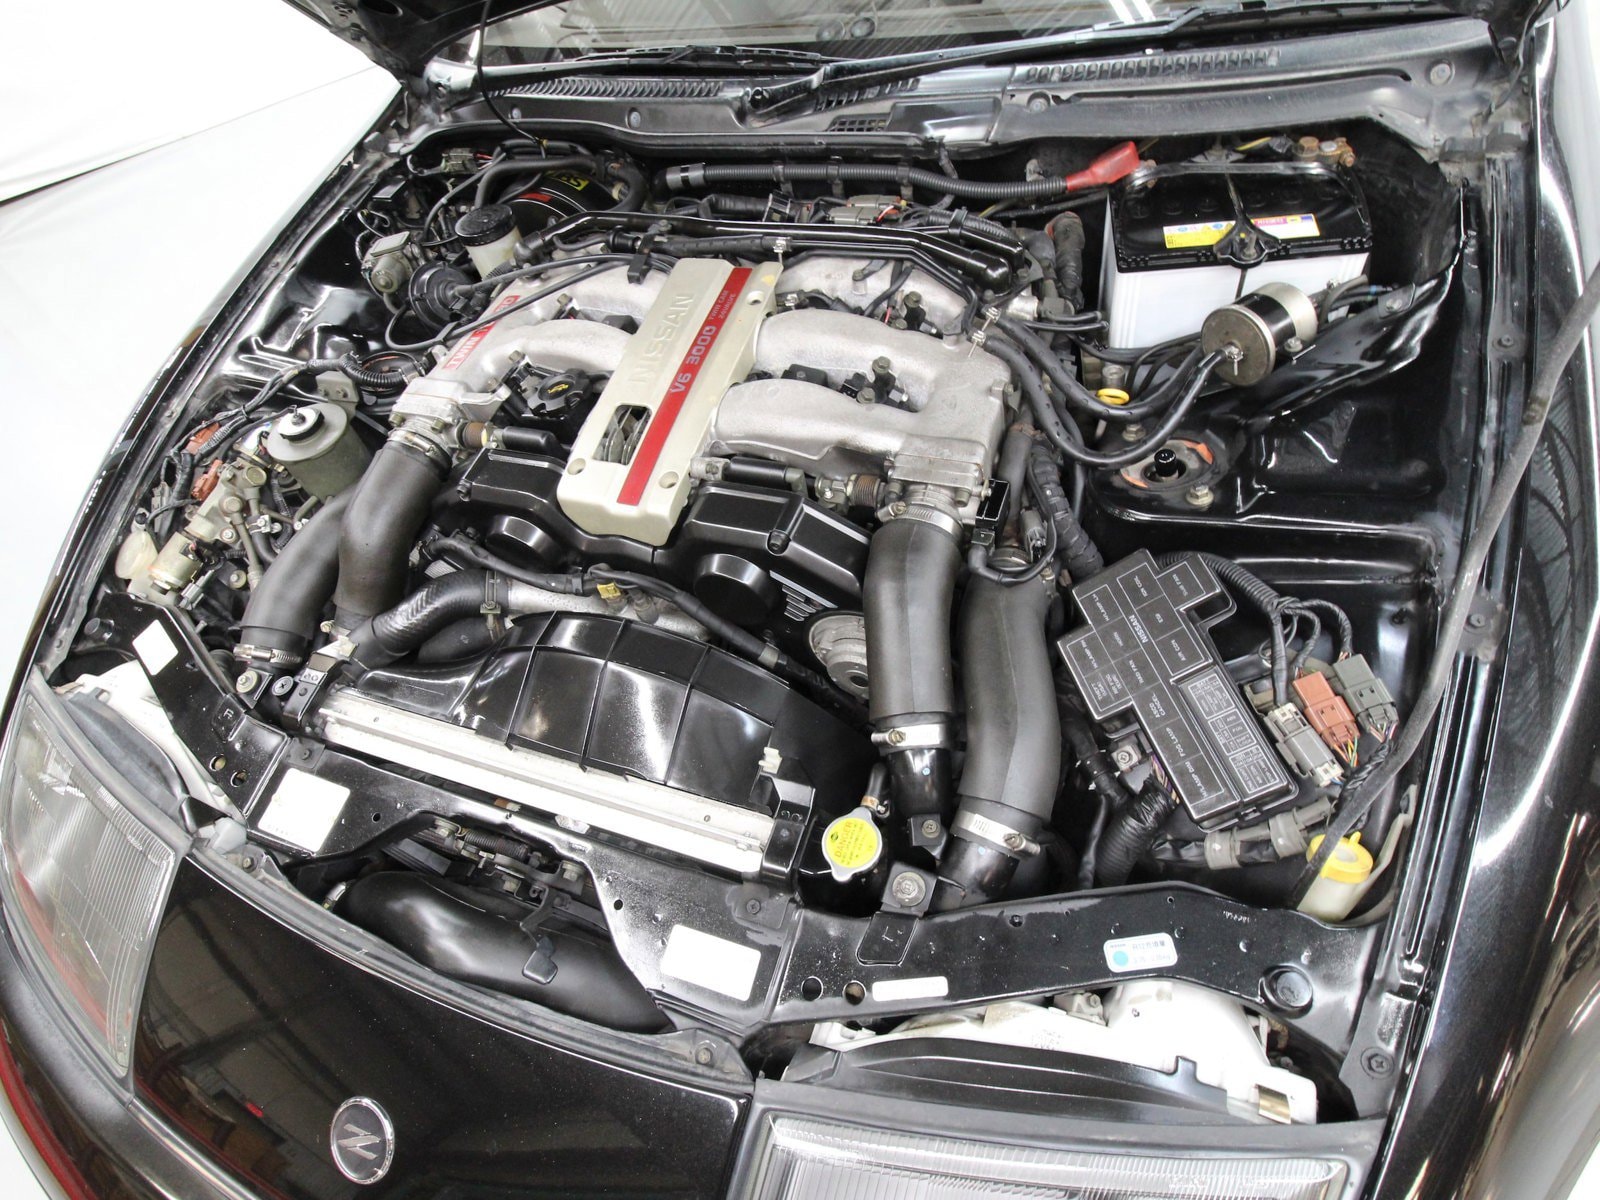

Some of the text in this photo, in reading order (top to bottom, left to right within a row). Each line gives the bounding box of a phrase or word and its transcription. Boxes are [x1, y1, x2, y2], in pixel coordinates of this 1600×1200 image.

[717, 289, 728, 303] CAM
[447, 335, 480, 368] TWIN
[628, 292, 695, 384] NISSAN
[670, 325, 716, 394] V6 3000
[1128, 614, 1148, 643] NISSAN
[1090, 681, 1103, 699] THEFT
[1150, 692, 1166, 715] CANCEL
[1165, 726, 1186, 756] FOG LAMP
[834, 821, 853, 858] DANGER
